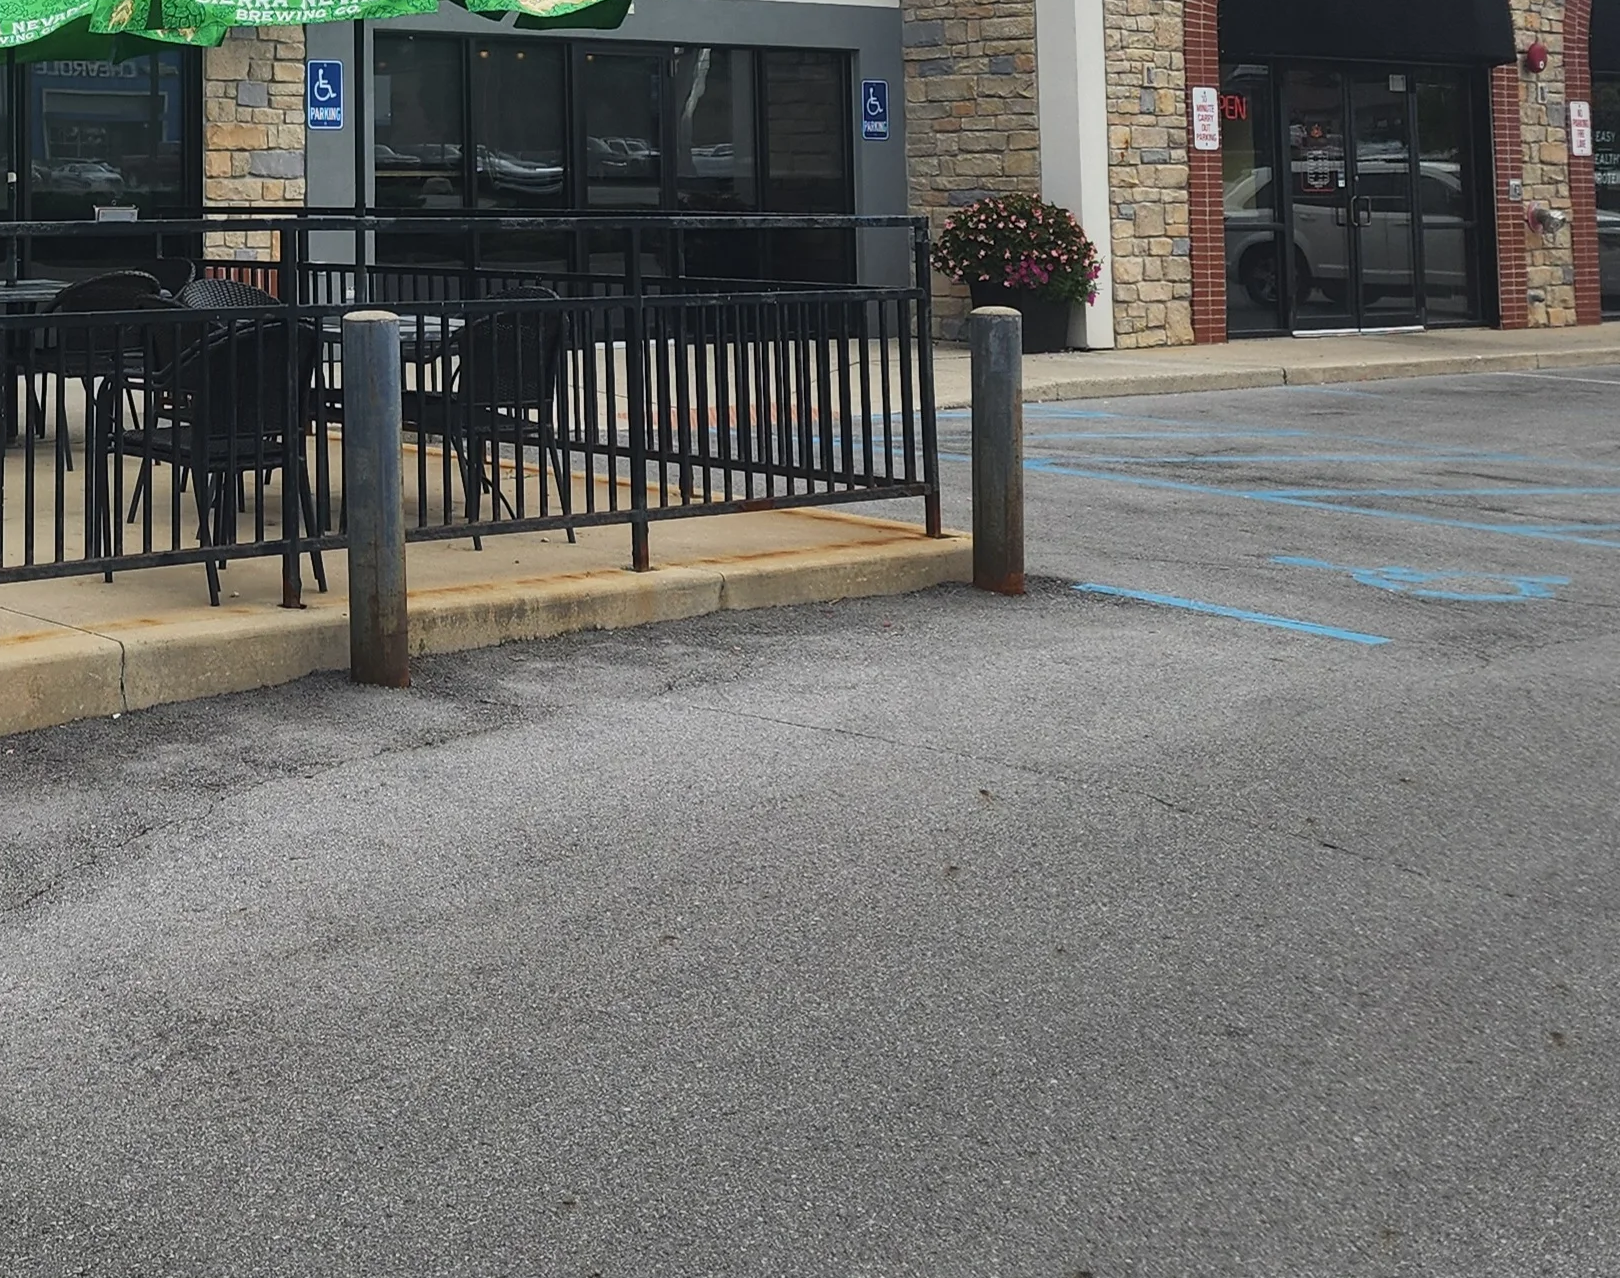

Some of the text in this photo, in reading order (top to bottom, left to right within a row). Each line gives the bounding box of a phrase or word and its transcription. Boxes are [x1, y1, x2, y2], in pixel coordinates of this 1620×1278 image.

[235, 9, 326, 23] BREWING
[1220, 95, 1247, 120] PEN
[310, 107, 341, 121] PARKING
[1198, 114, 1214, 122] CARRY
[1201, 123, 1211, 132] OUT
[1196, 133, 1217, 142] PARKING
[1595, 130, 1616, 143] EASY
[1594, 153, 1620, 165] EALTH
